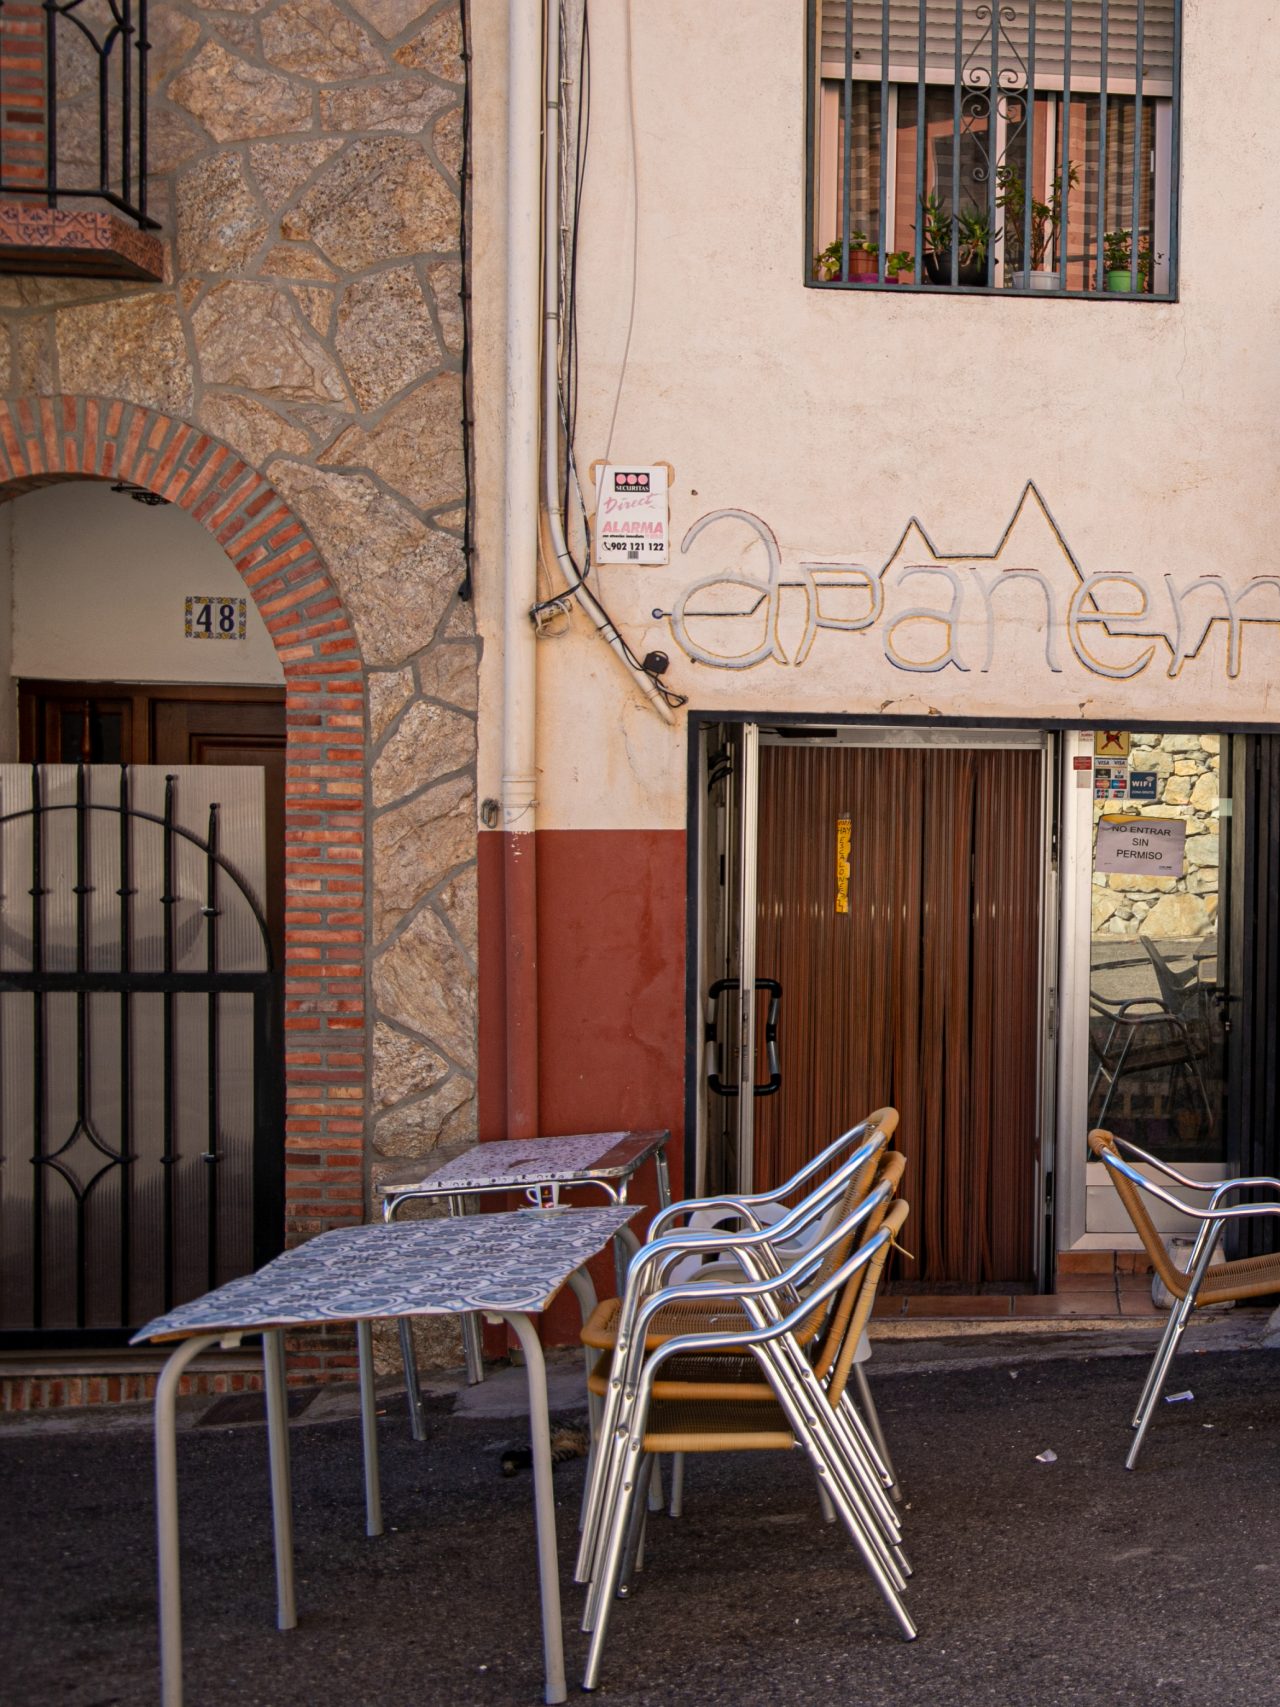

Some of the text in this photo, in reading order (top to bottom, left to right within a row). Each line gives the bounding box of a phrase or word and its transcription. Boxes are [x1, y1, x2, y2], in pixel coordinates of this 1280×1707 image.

[603, 521, 663, 534] ALARMA
[611, 542, 664, 552] 902 121 122
[196, 604, 235, 633] 48
[1112, 825, 1171, 836] NO ENTRAR
[1132, 838, 1149, 847] SIN
[1116, 849, 1163, 860] PERMISO
